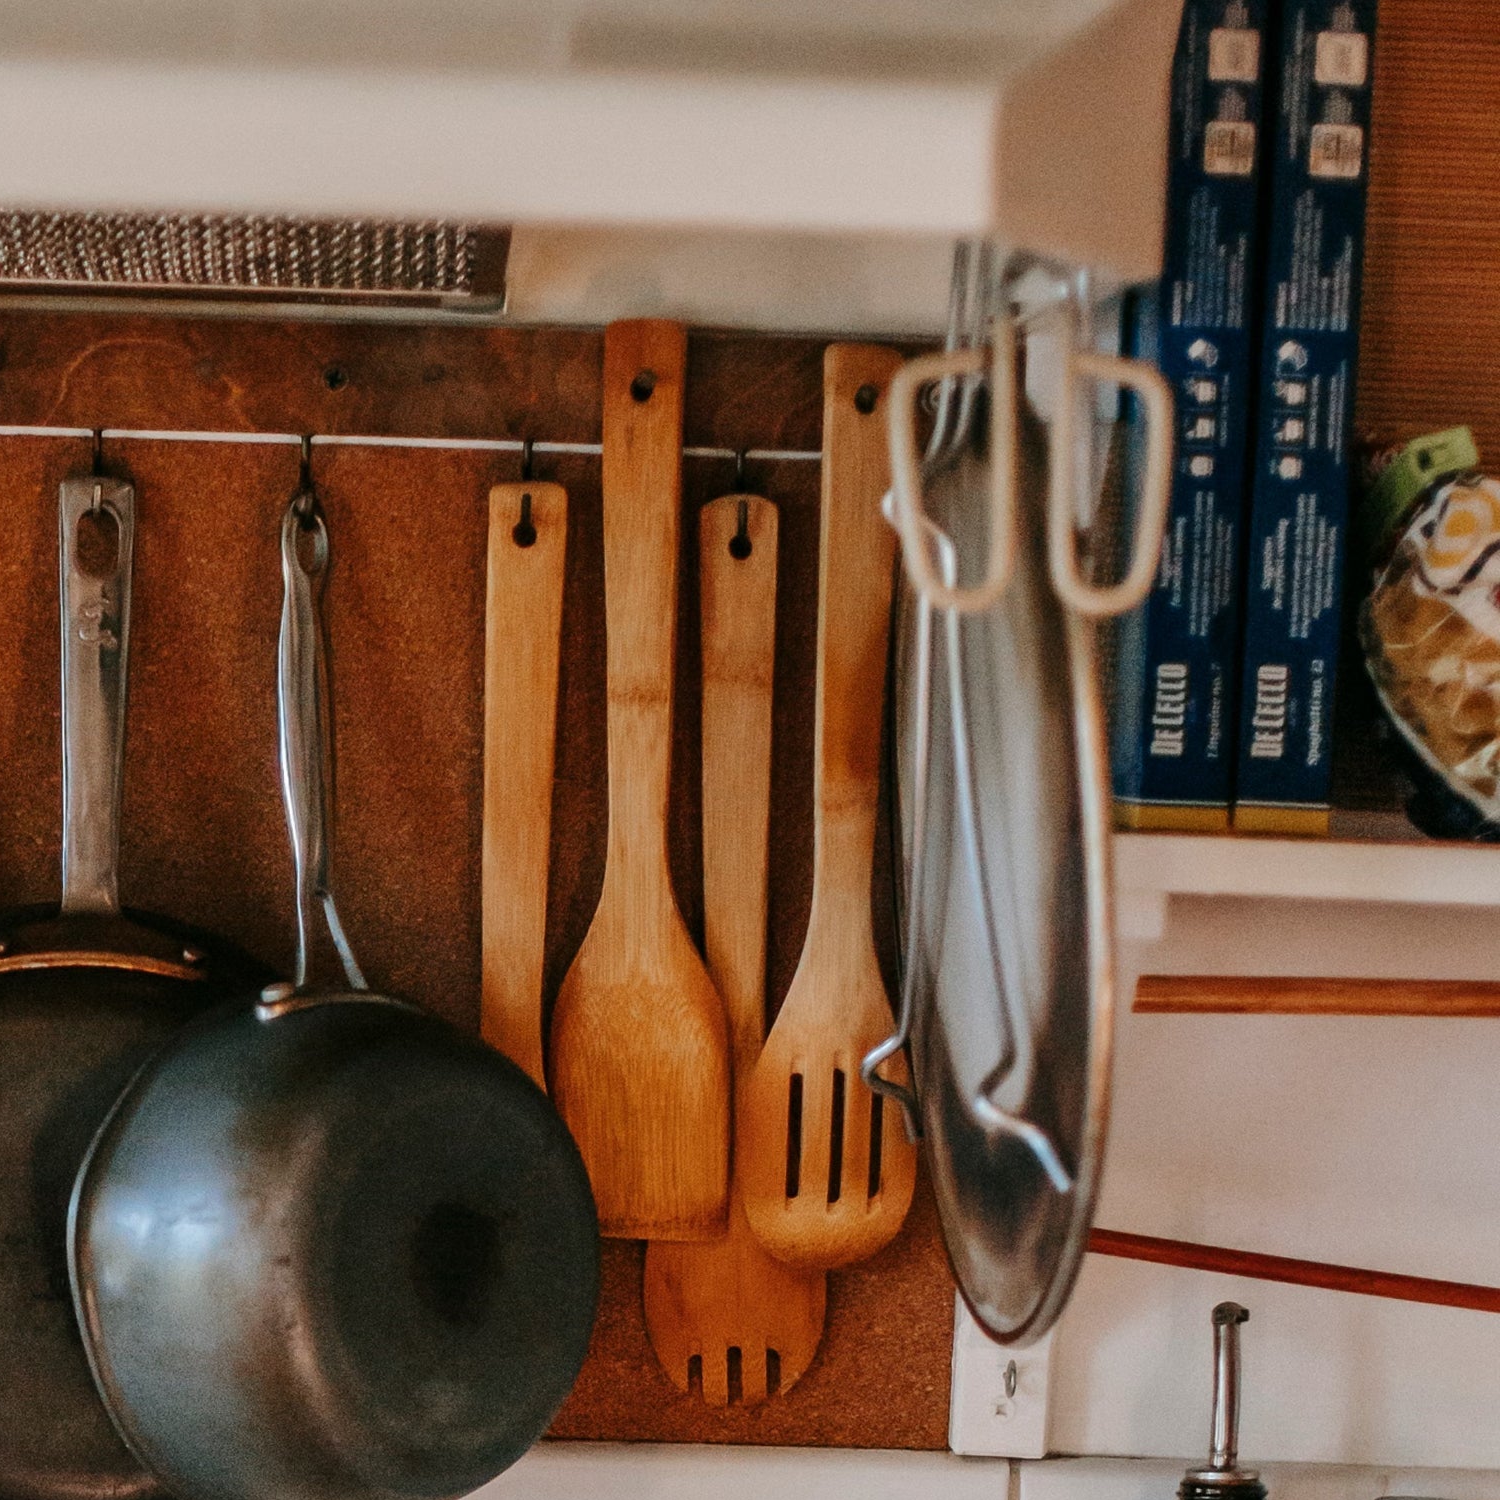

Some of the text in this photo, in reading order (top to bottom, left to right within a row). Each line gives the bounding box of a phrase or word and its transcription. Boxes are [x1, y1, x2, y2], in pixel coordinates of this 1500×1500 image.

[1152, 662, 1188, 727] CECCO
[1252, 664, 1288, 728] CECCO
[1306, 700, 1325, 766] Spaghetti
